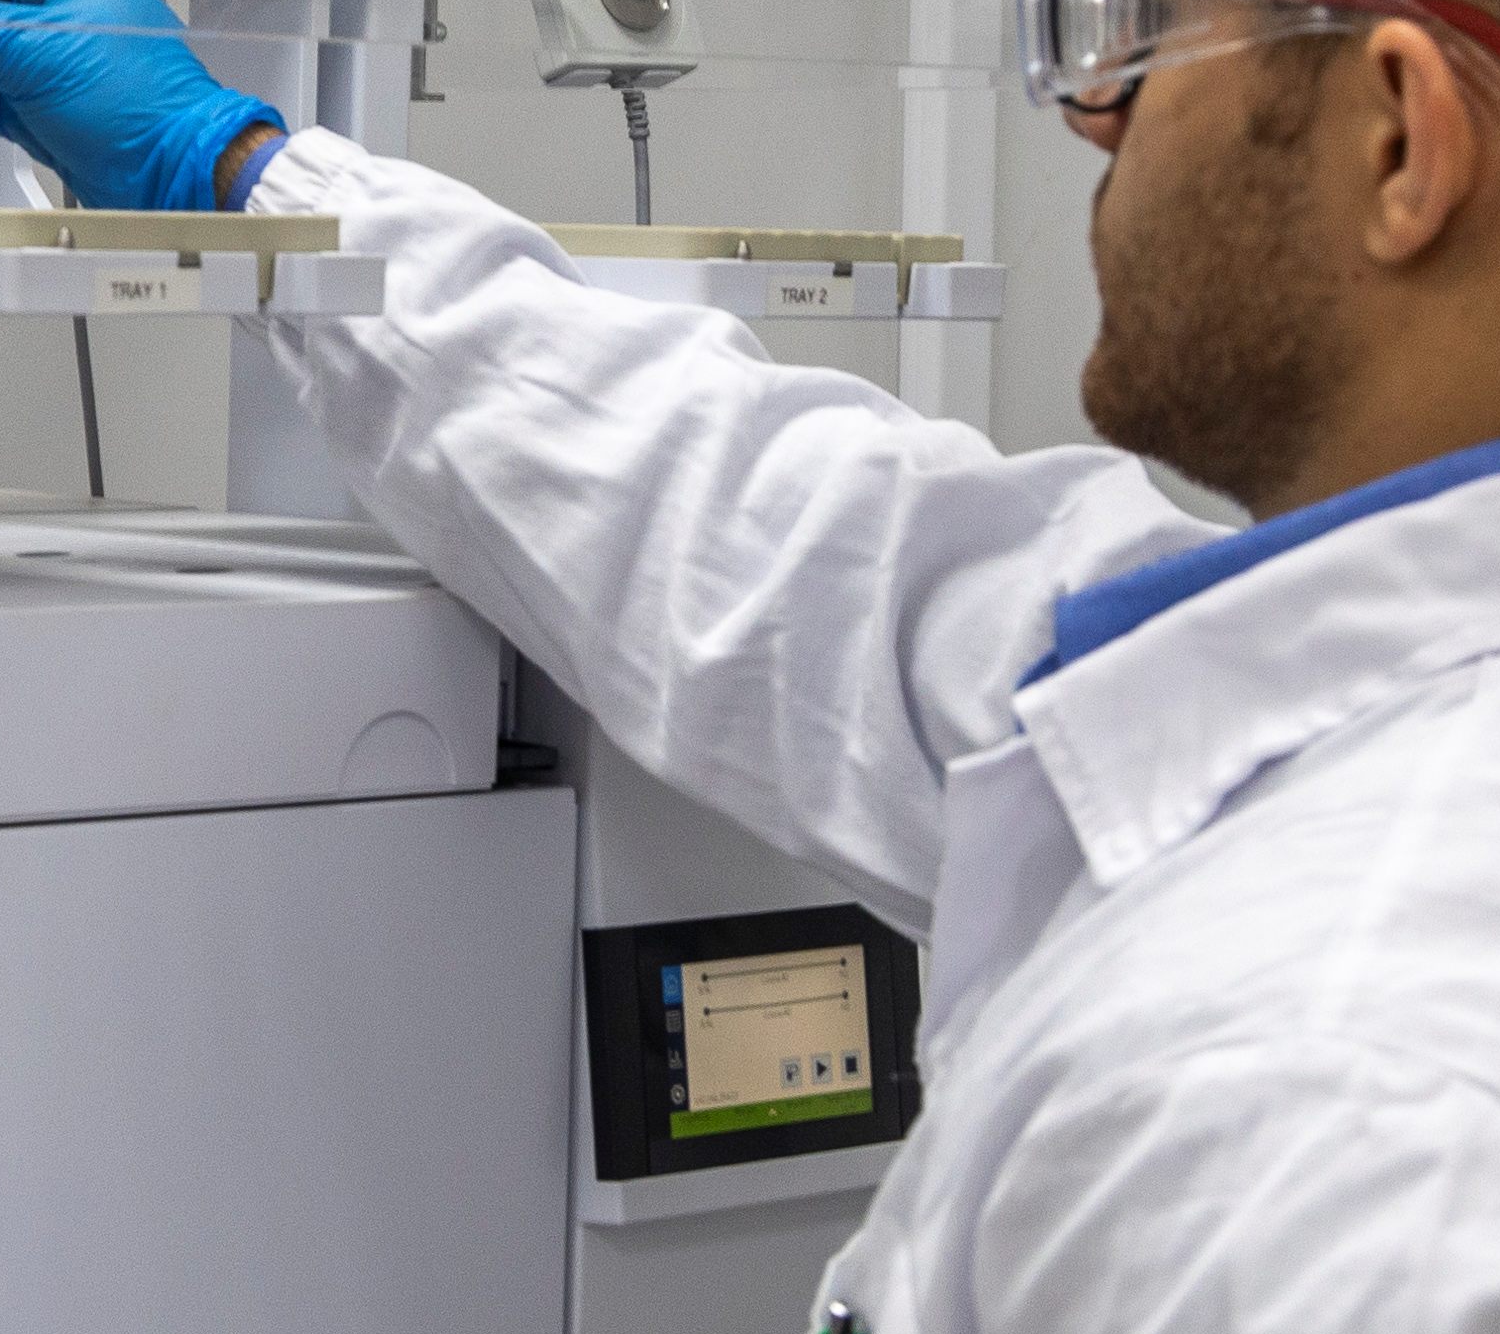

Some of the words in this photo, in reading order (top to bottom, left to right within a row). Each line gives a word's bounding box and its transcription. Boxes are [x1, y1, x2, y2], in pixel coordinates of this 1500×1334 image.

[111, 280, 153, 299] TRAY
[159, 281, 167, 299] 1
[781, 286, 815, 304] TRAY
[818, 287, 828, 305] 2
